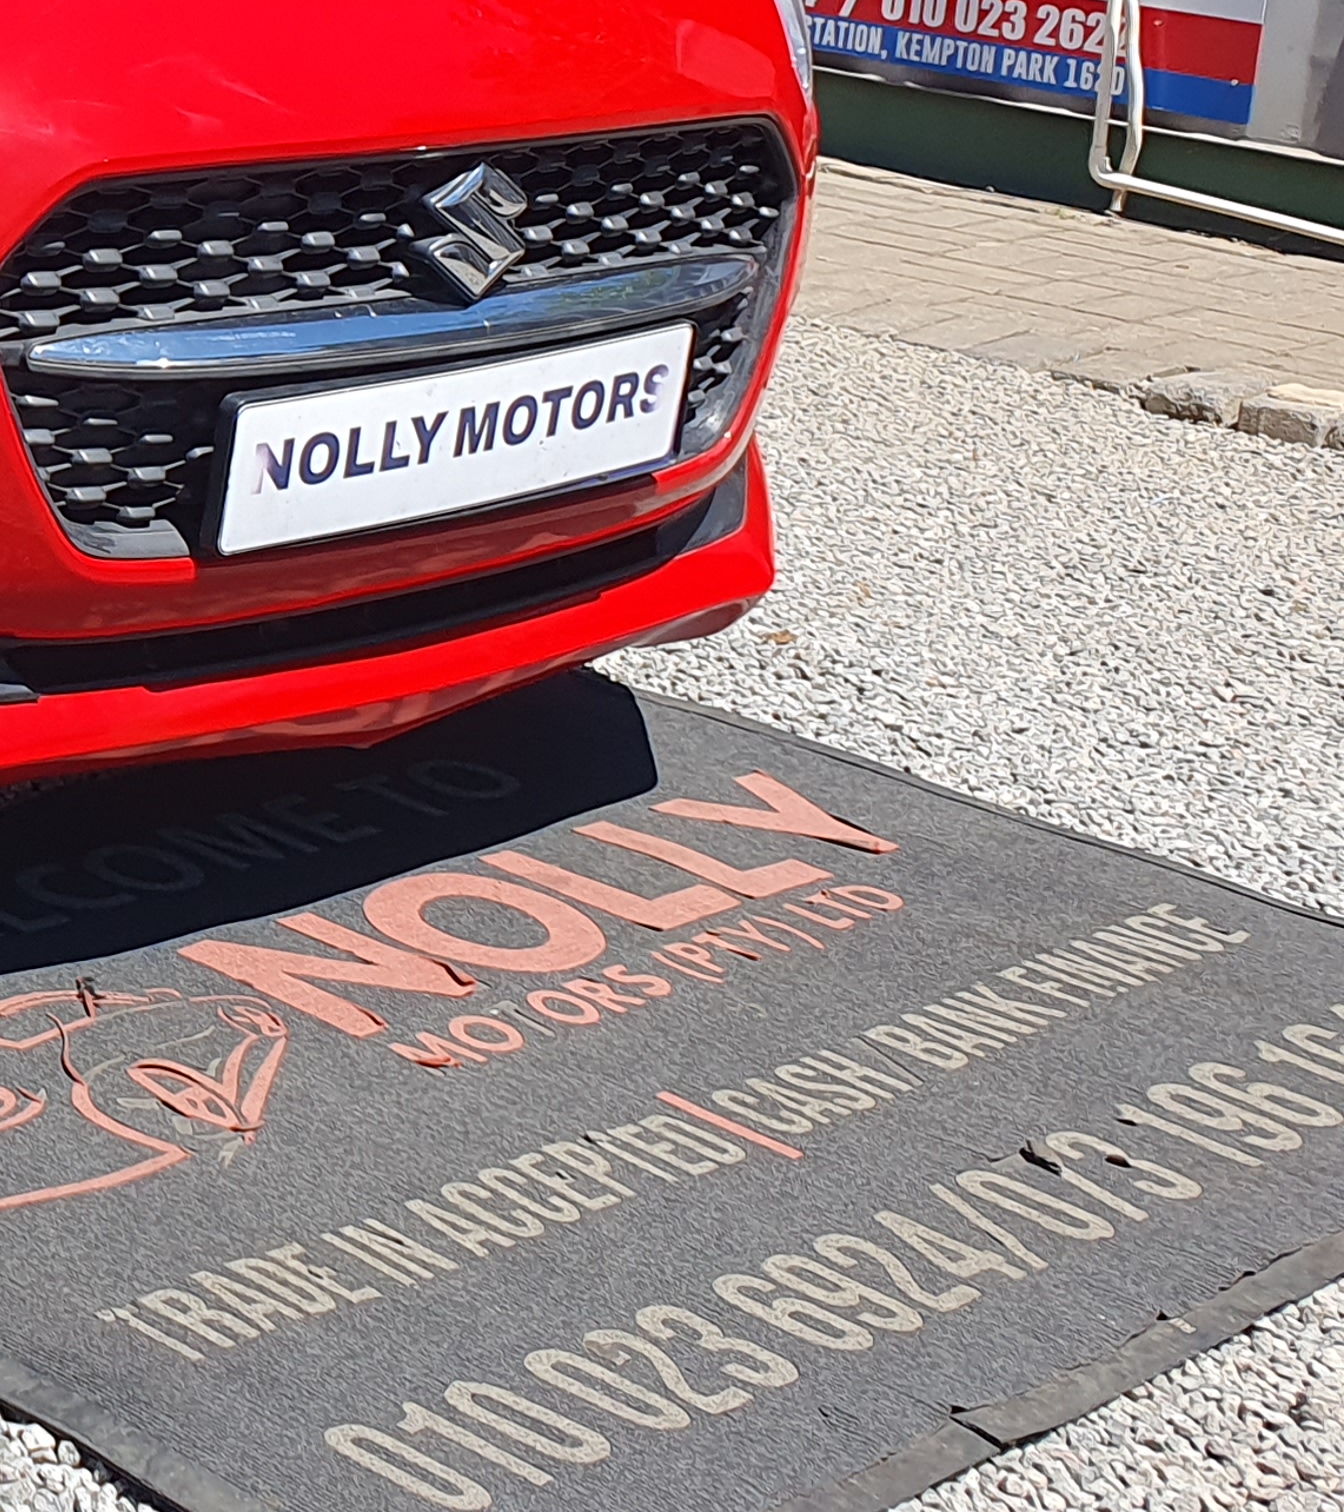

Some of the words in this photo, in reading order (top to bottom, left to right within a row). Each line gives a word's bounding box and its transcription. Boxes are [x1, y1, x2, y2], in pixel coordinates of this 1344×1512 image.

[895, 29, 996, 73] KEMPTON
[1000, 48, 1060, 86] PARK
[1063, 58, 1126, 96] 160
[250, 409, 450, 496] NOLLY
[452, 362, 671, 458] MOTORS
[339, 758, 523, 819] TO
[176, 769, 901, 1038] NOLLY
[387, 963, 673, 1074] MOTORS
[649, 914, 825, 985] (PTY)
[801, 884, 904, 931] LTD
[94, 1241, 383, 1363] TRADE
[320, 1217, 461, 1289] IN
[404, 1113, 747, 1258] ACCEPTED
[1002, 901, 1252, 1008] FINANCE
[323, 1378, 612, 1511] 010
[522, 1304, 801, 1431] 023
[1115, 1061, 1344, 1168] 196
